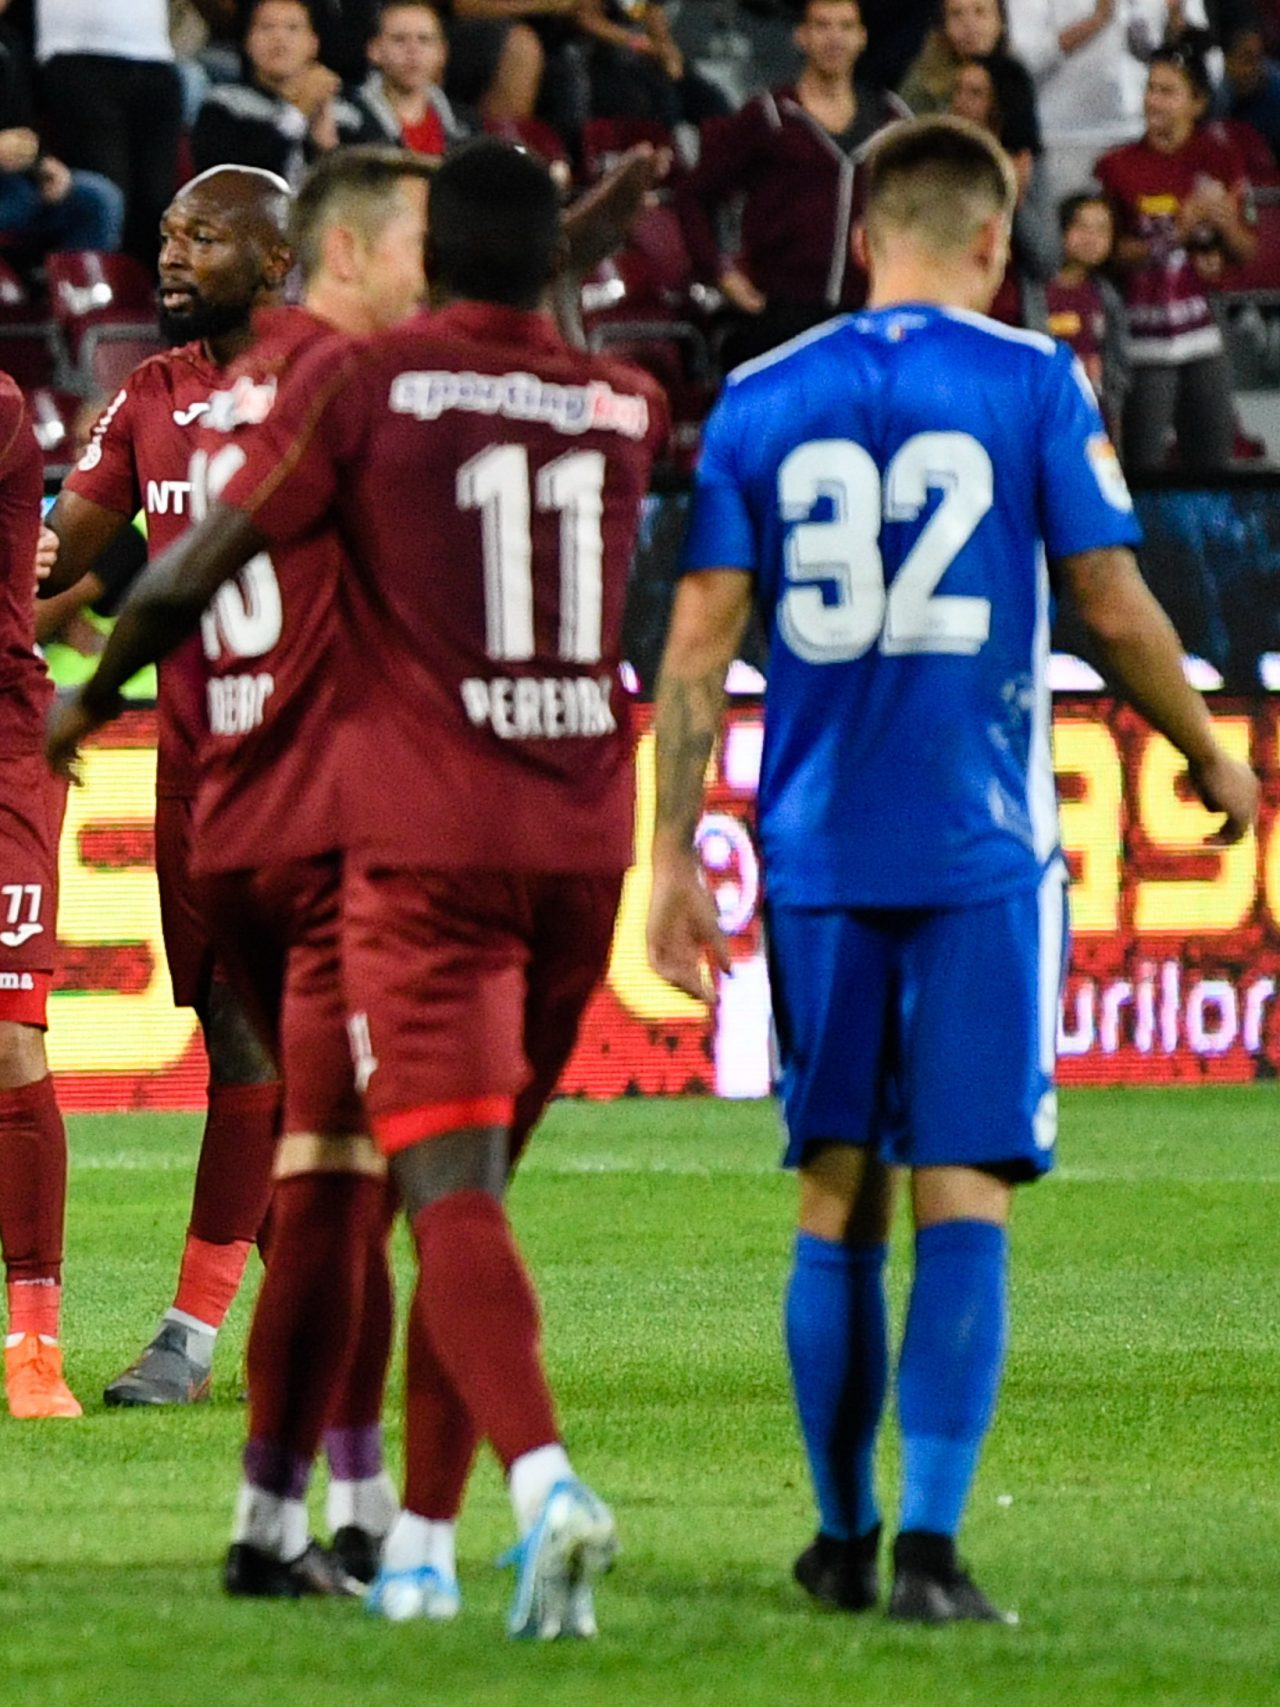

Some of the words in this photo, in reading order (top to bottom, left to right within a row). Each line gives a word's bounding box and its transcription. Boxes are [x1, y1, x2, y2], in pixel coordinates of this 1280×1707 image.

[456, 443, 606, 665] 11
[776, 431, 994, 664] 32
[1, 884, 43, 924] 77
